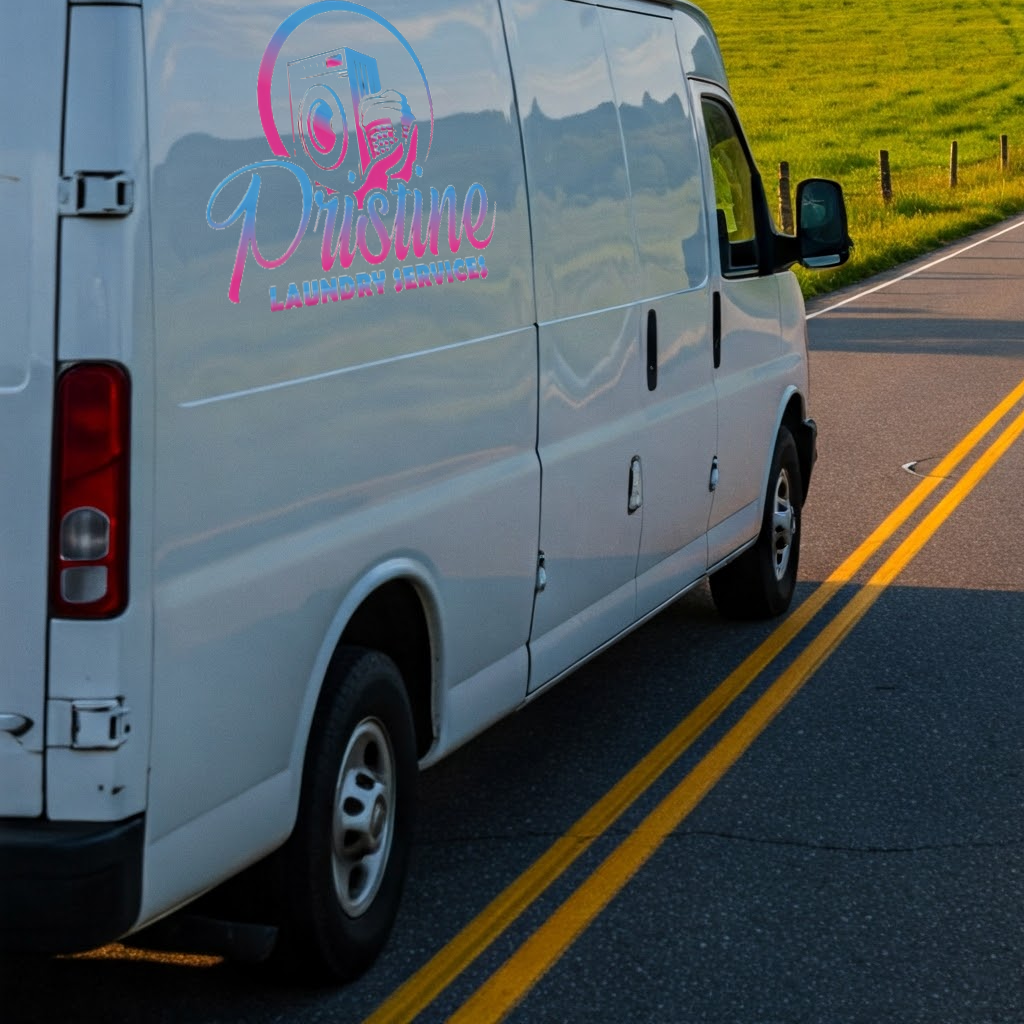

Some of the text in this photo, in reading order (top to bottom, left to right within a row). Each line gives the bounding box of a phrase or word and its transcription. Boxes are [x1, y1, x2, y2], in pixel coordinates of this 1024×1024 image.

[206, 159, 497, 304] Pristine
[269, 255, 489, 312] LAUNDRY SERVICES
